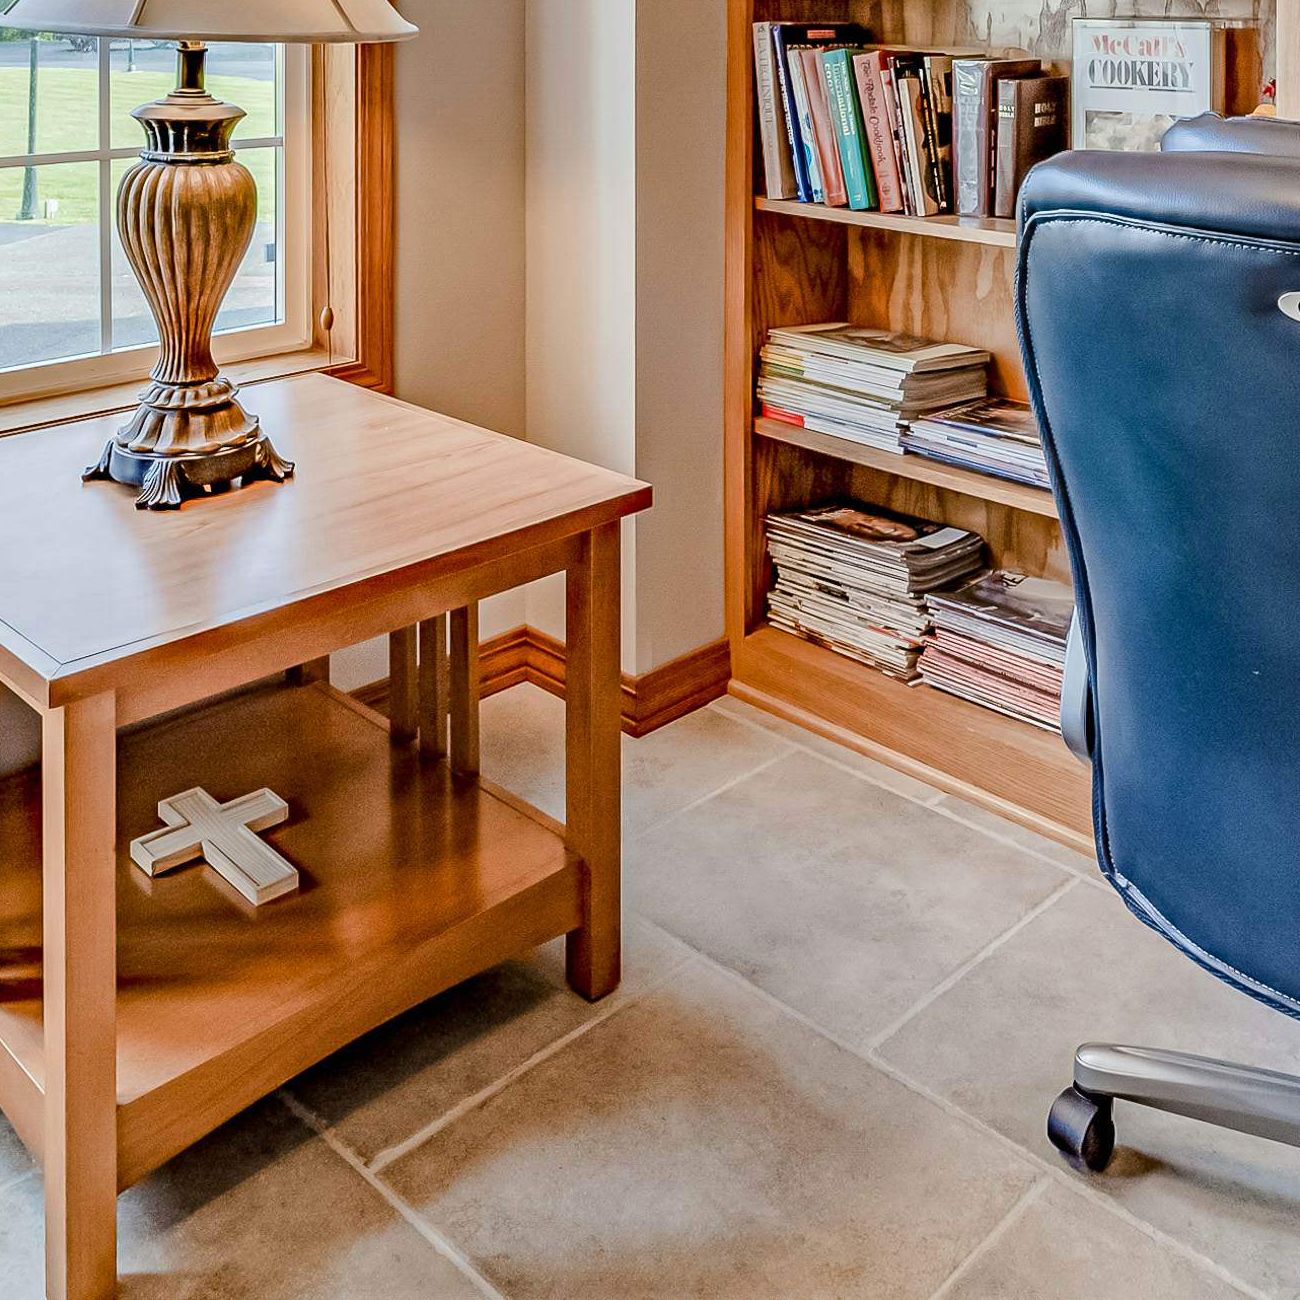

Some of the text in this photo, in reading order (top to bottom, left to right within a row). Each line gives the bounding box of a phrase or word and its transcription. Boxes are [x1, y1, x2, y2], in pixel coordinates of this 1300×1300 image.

[1088, 59, 1193, 88] COOKERY
[833, 62, 850, 136] International
[869, 116, 884, 165] Cookbook
